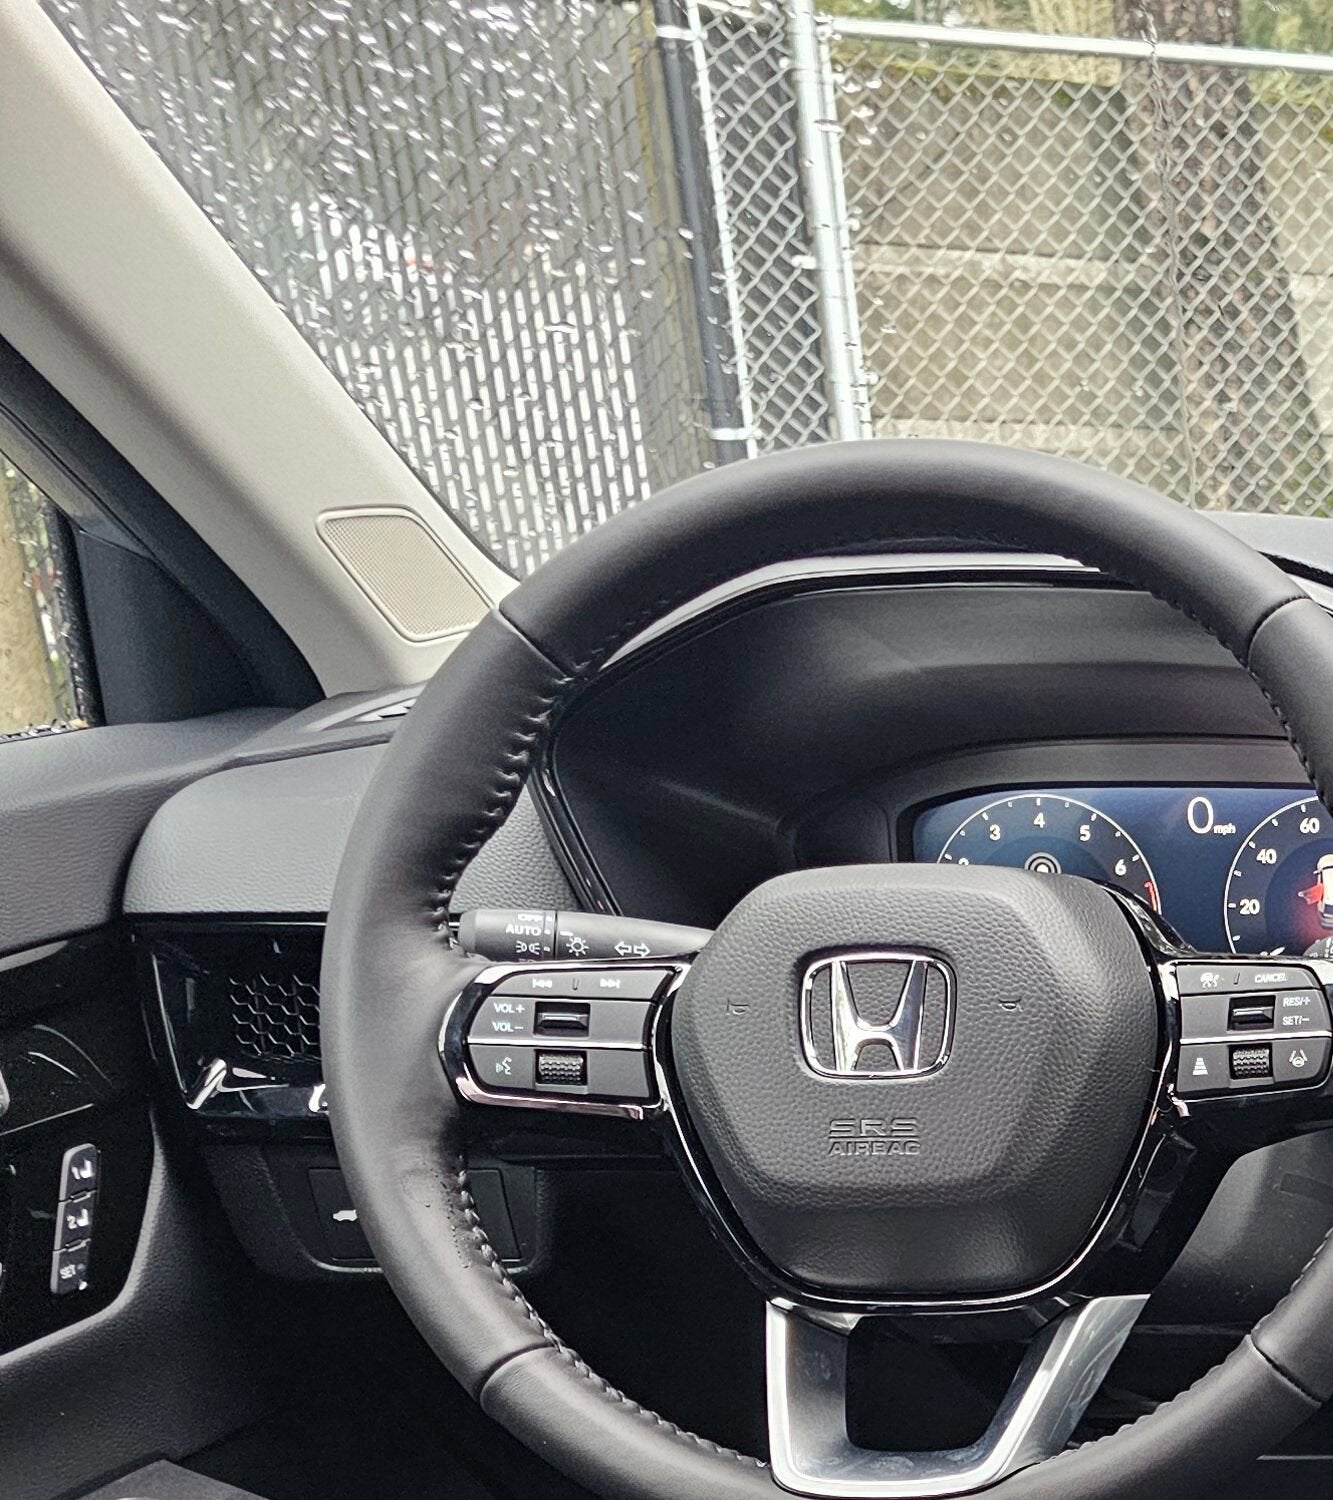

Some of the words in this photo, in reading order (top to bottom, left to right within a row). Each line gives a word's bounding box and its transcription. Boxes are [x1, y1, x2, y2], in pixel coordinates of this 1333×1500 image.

[1033, 812, 1045, 828] 4
[1188, 796, 1214, 834] 0
[1213, 823, 1236, 836] mph
[989, 824, 1000, 841] 3
[1080, 825, 1091, 841] 5
[1300, 817, 1320, 834] 60
[1256, 848, 1277, 865] 40
[1115, 859, 1126, 876] 6
[1239, 899, 1260, 915] 20
[506, 924, 541, 935] AUTO
[1255, 973, 1286, 983] CANCEL
[829, 1118, 920, 1137] SRS
[828, 1140, 921, 1156] AIRBAG
[66, 1215, 77, 1230] 2
[59, 1264, 76, 1279] SET
